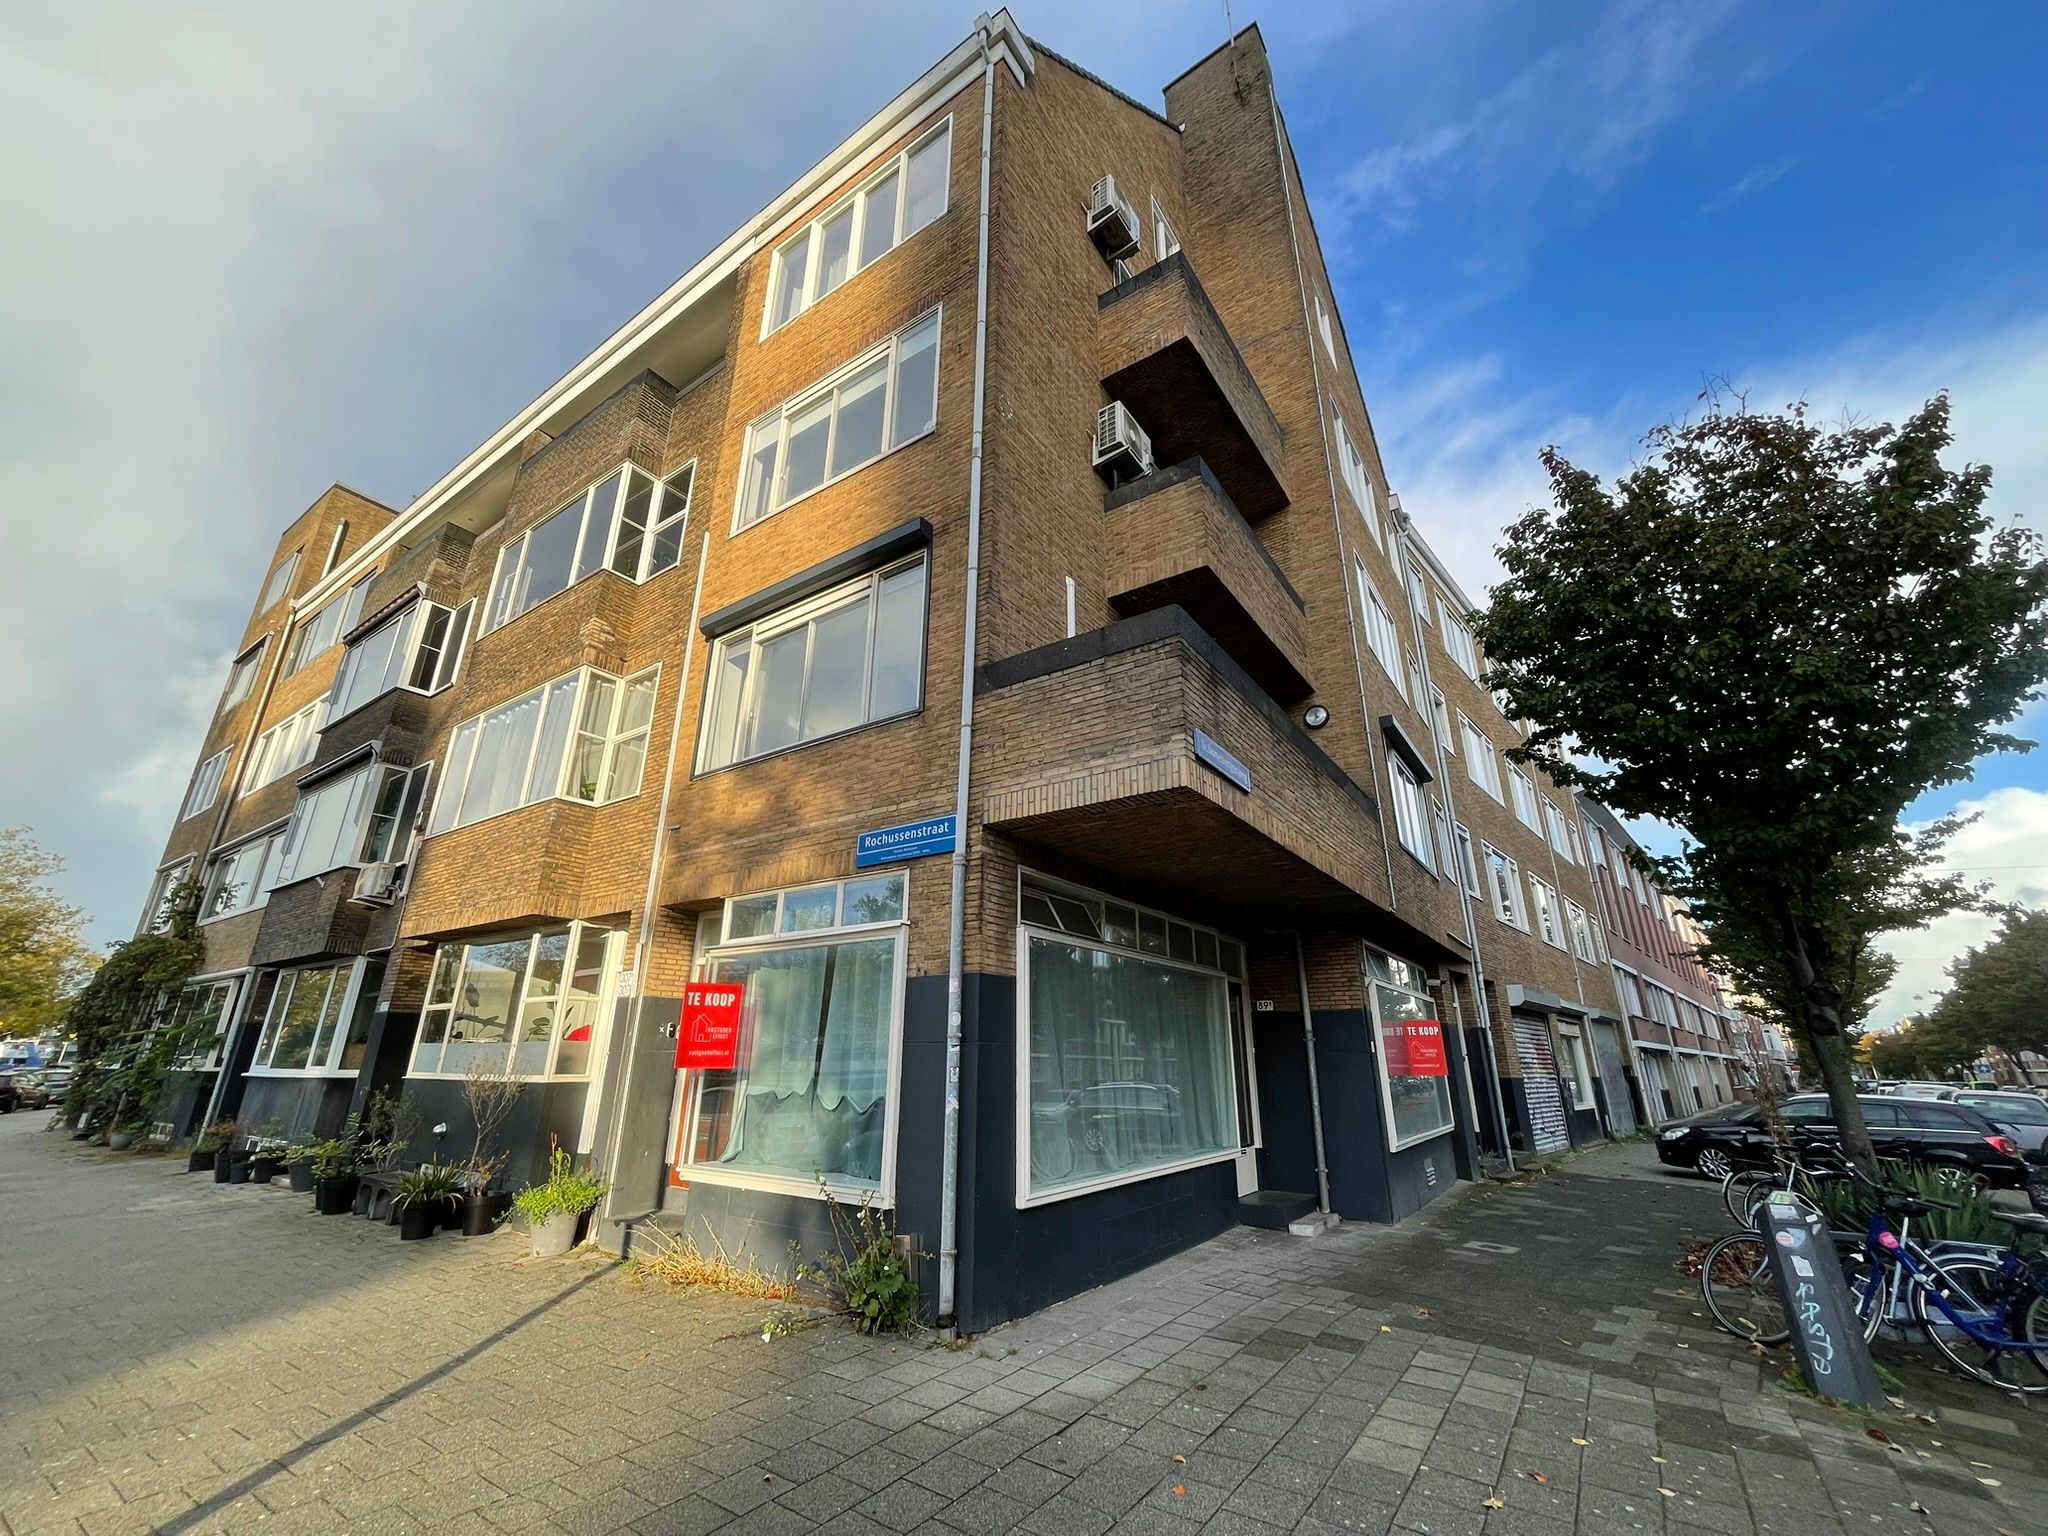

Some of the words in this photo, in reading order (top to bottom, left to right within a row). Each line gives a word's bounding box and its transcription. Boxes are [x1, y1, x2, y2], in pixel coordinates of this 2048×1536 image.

[865, 822, 949, 848] Rochussenstraat
[688, 992, 701, 1006] TE
[704, 992, 735, 1007] KOOP
[1407, 1026, 1417, 1036] TE
[1418, 1026, 1439, 1036] KOOP
